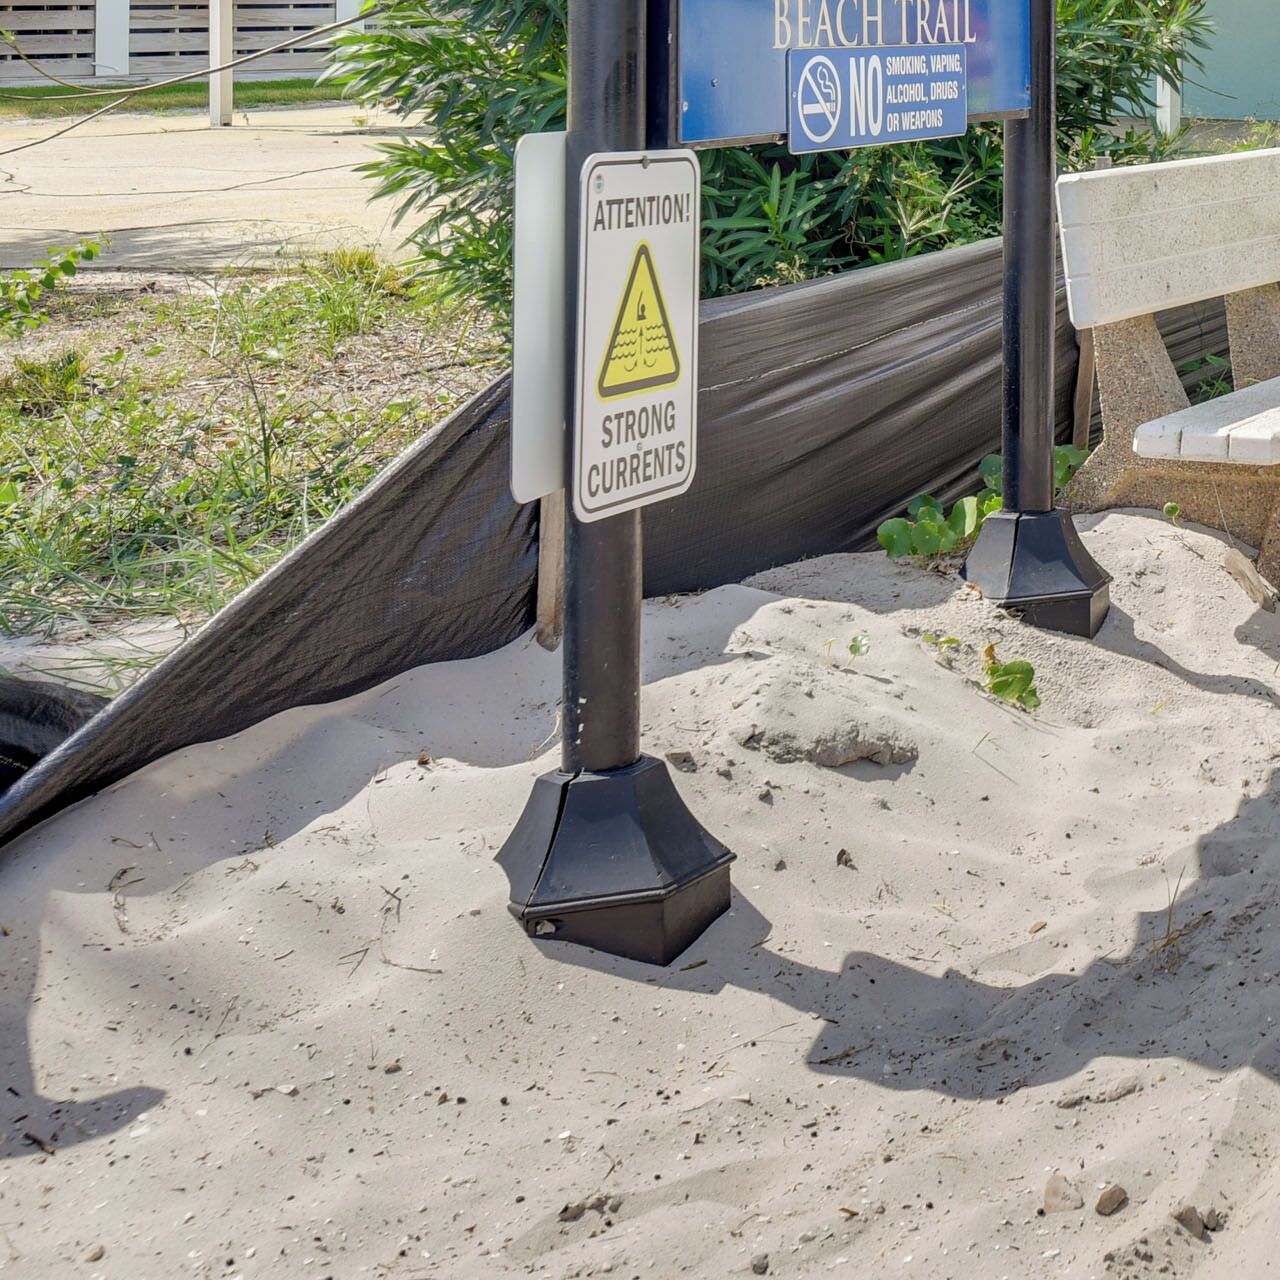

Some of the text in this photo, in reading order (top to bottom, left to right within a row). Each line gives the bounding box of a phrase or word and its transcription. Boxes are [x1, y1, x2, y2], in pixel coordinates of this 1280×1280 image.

[886, 53, 963, 76] SMOKING, VAPING,
[849, 55, 883, 137] NO
[886, 80, 958, 104] ALCOHOL, DRUGS
[887, 109, 943, 133] OR WEAPONS
[593, 193, 691, 232] ATTENTION!
[601, 400, 676, 449] STRONG
[587, 440, 686, 498] CURRENTS
